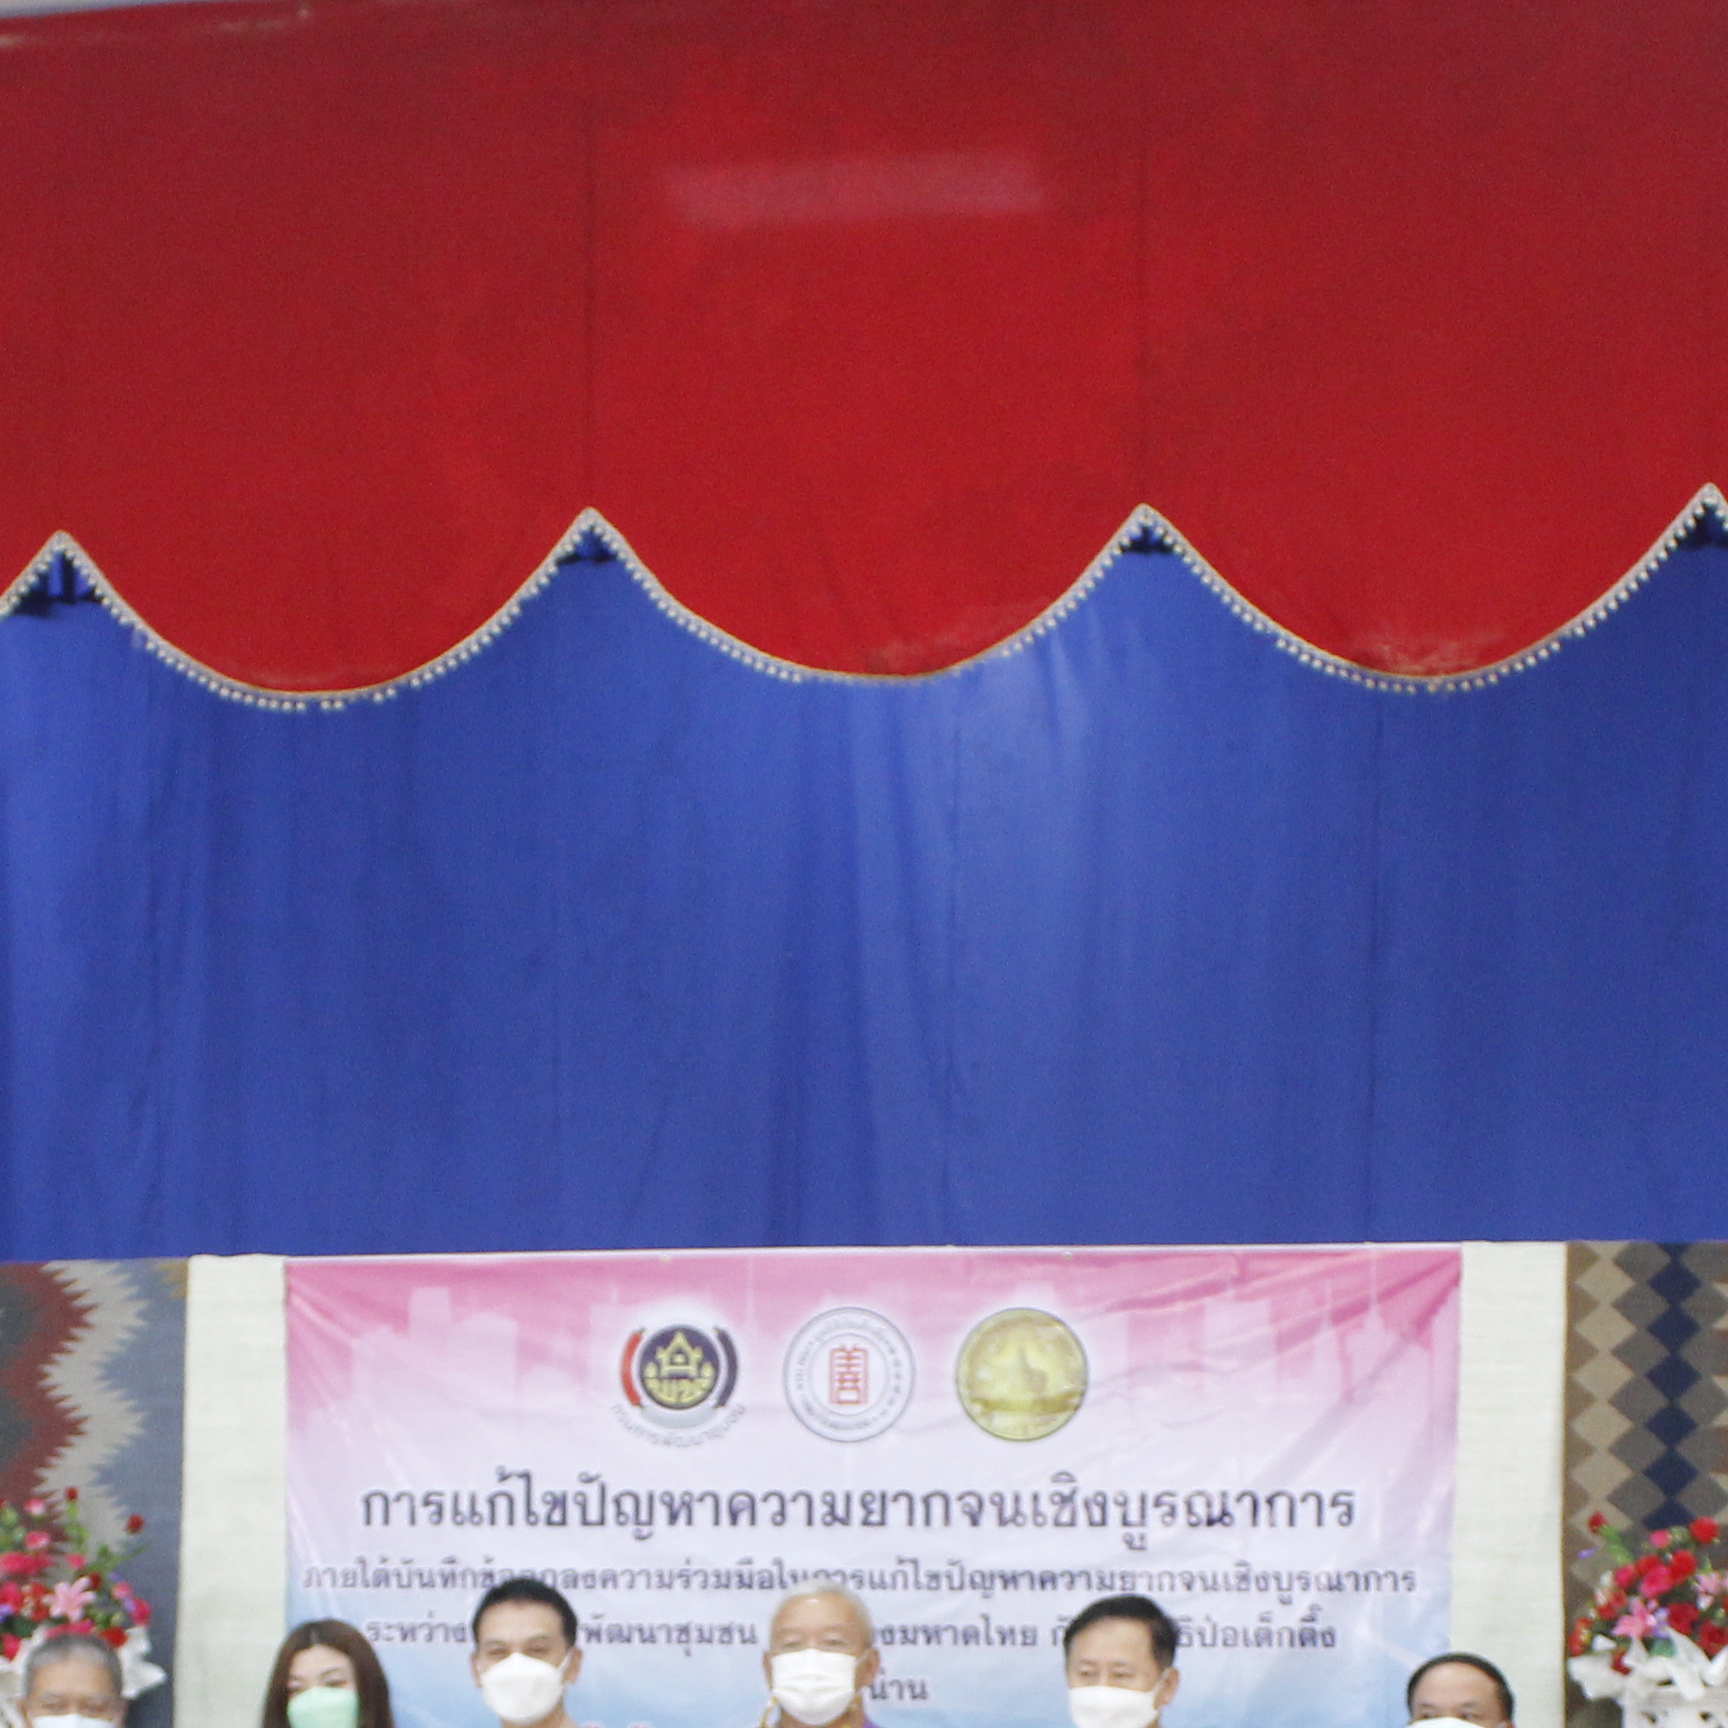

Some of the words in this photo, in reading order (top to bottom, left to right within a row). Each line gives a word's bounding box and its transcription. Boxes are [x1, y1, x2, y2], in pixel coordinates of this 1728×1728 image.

[360, 1466, 1356, 1551] การแก้ไขปัญหาความยากจนเชิงบูรณาการ
